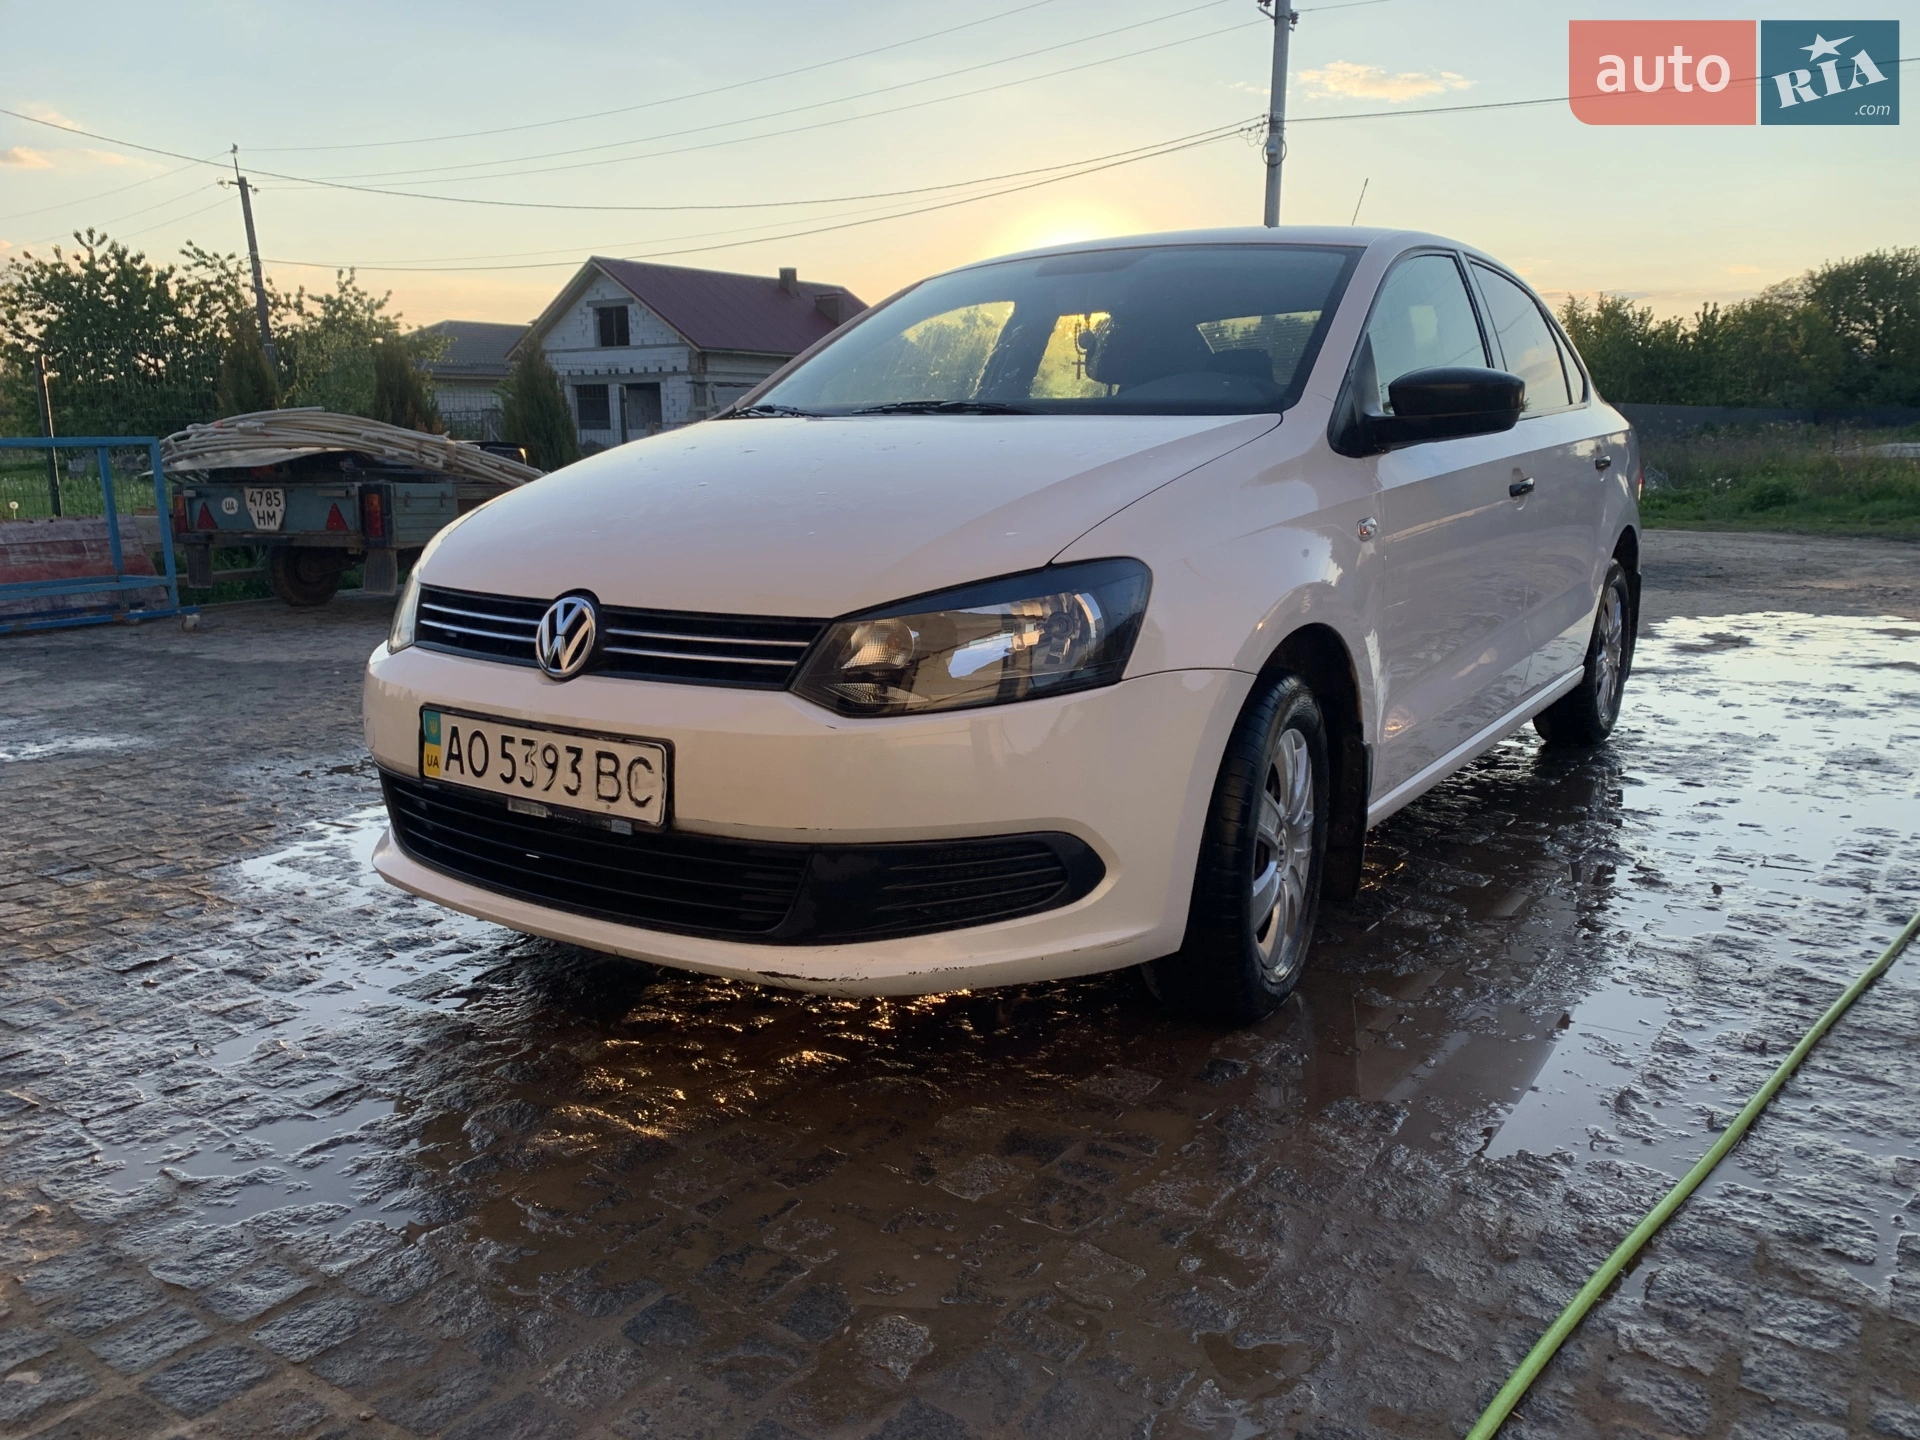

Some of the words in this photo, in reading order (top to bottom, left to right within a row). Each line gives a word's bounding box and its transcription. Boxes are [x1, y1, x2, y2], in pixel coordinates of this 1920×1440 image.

[224, 500, 236, 511] UA
[249, 491, 281, 507] 4785
[256, 510, 277, 526] HM
[426, 753, 440, 770] UA
[445, 725, 490, 778] AO
[499, 734, 583, 797] 5393
[595, 750, 655, 808] BC
